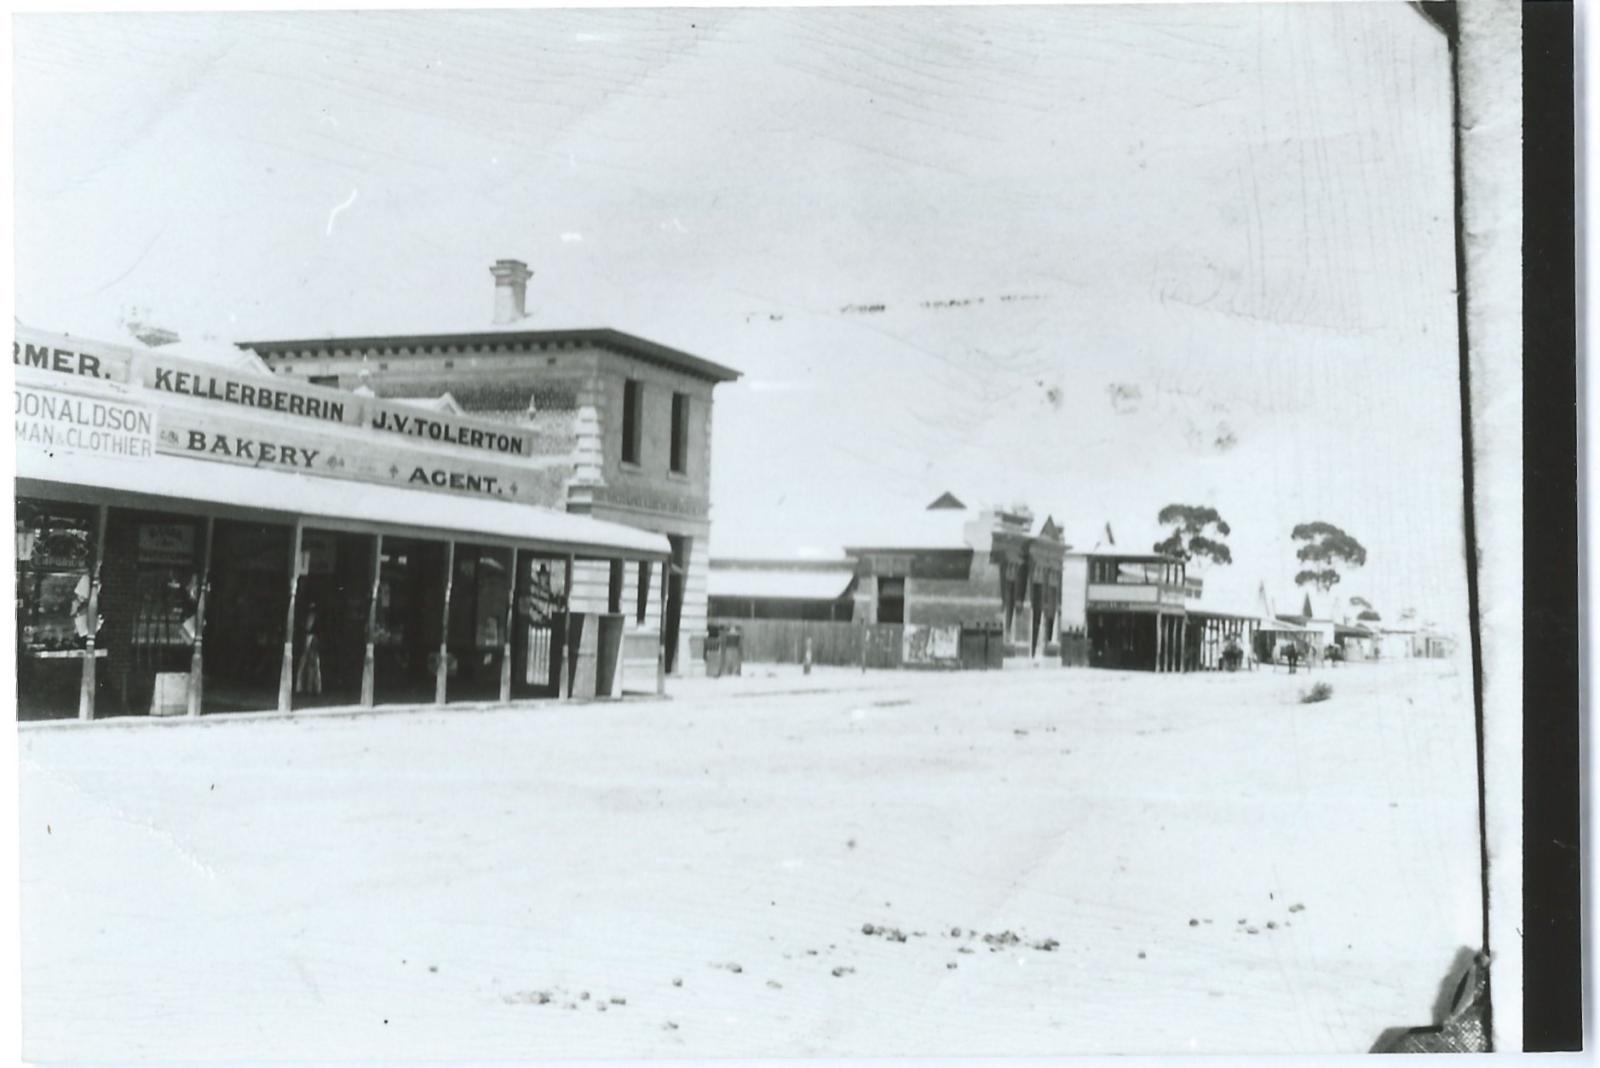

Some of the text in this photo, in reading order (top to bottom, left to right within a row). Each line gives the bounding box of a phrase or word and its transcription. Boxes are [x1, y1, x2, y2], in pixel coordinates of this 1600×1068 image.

[154, 366, 344, 422] KELLERBERRIN
[66, 427, 152, 458] CLOTHIER
[187, 429, 319, 468] BAKERY
[408, 466, 502, 494] AGENT.
